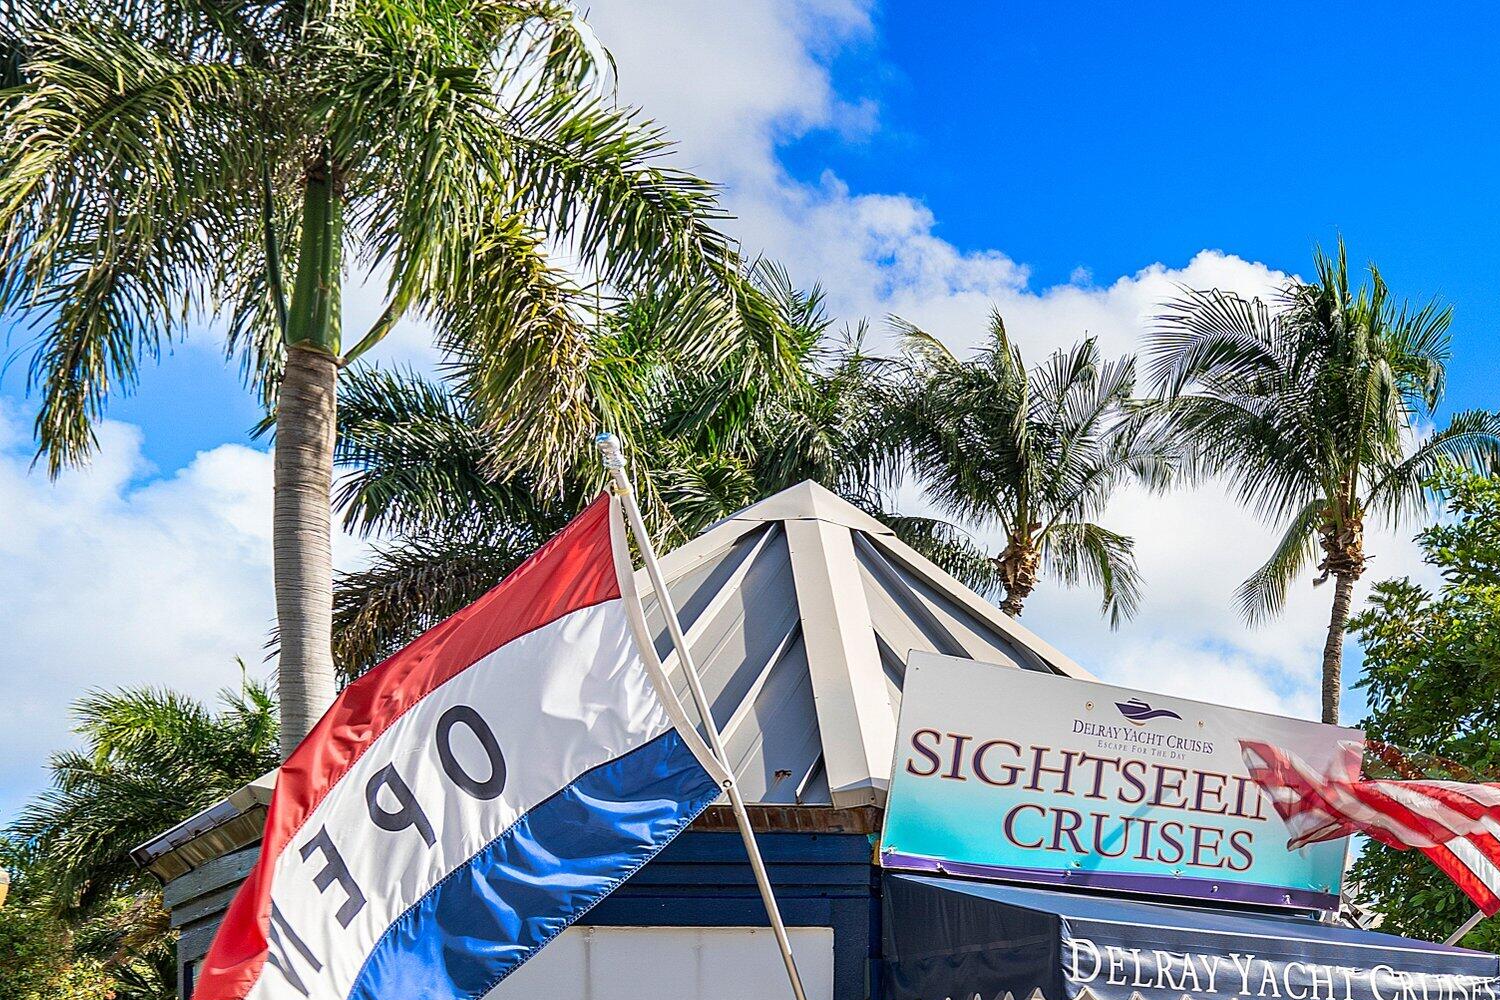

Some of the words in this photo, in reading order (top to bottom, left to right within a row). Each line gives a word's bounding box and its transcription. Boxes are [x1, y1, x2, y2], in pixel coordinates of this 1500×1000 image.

[1072, 719, 1124, 741] DELRAY
[1122, 724, 1165, 746] YACHT
[1166, 733, 1214, 755] CRUISES
[905, 727, 1268, 823] SIGHTSEEI
[1003, 803, 1255, 872] CRUISES
[1070, 937, 1220, 993] DELRAY
